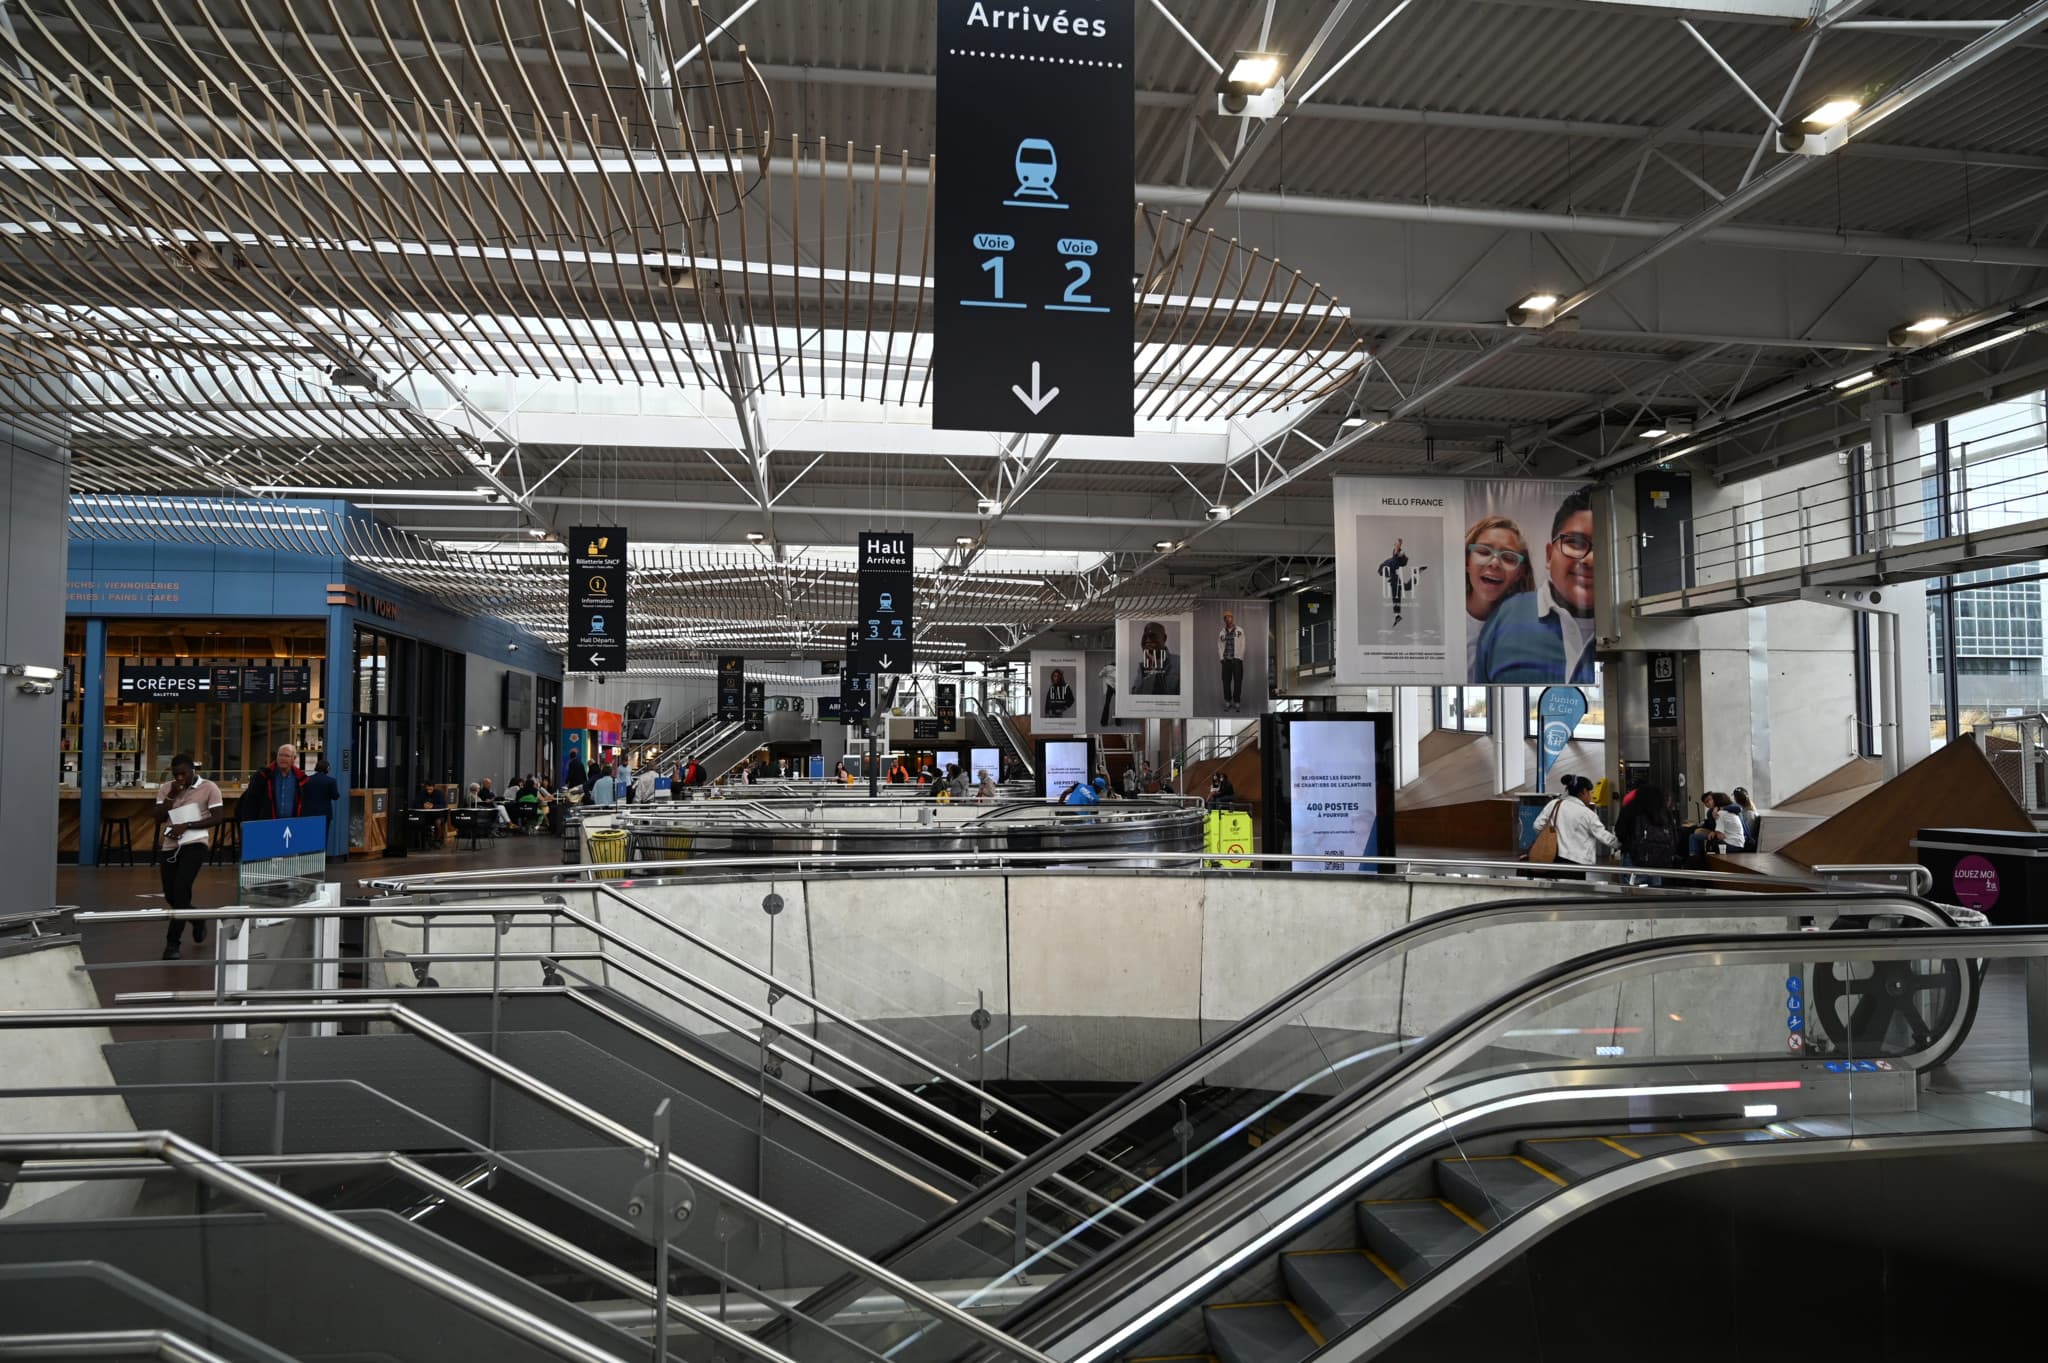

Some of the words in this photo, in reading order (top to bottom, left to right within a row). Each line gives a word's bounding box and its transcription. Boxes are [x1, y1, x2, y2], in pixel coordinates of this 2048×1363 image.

[966, 1, 1107, 38] Arrivées
[978, 235, 1009, 249] Voie
[1062, 240, 1093, 254] Voie
[981, 256, 1004, 299] 1
[1063, 260, 1092, 304] 2
[1381, 498, 1409, 506] HELLO
[1410, 498, 1444, 507] FRANCE
[867, 539, 905, 554] Hall
[866, 556, 906, 565] Arrivées
[870, 625, 879, 638] 3
[892, 625, 902, 639] 4
[1143, 649, 1167, 669] GAP
[136, 676, 196, 690] CRÊPES
[1050, 684, 1069, 700] GAP
[1550, 694, 1579, 706] Junior
[1557, 704, 1573, 714] Cie
[1653, 703, 1660, 717] 3
[1668, 703, 1675, 716] 4
[1307, 803, 1323, 811] 400
[1324, 802, 1359, 811] POSTES
[1955, 869, 1979, 879] LOUEZ
[1980, 870, 1995, 879] MOI
